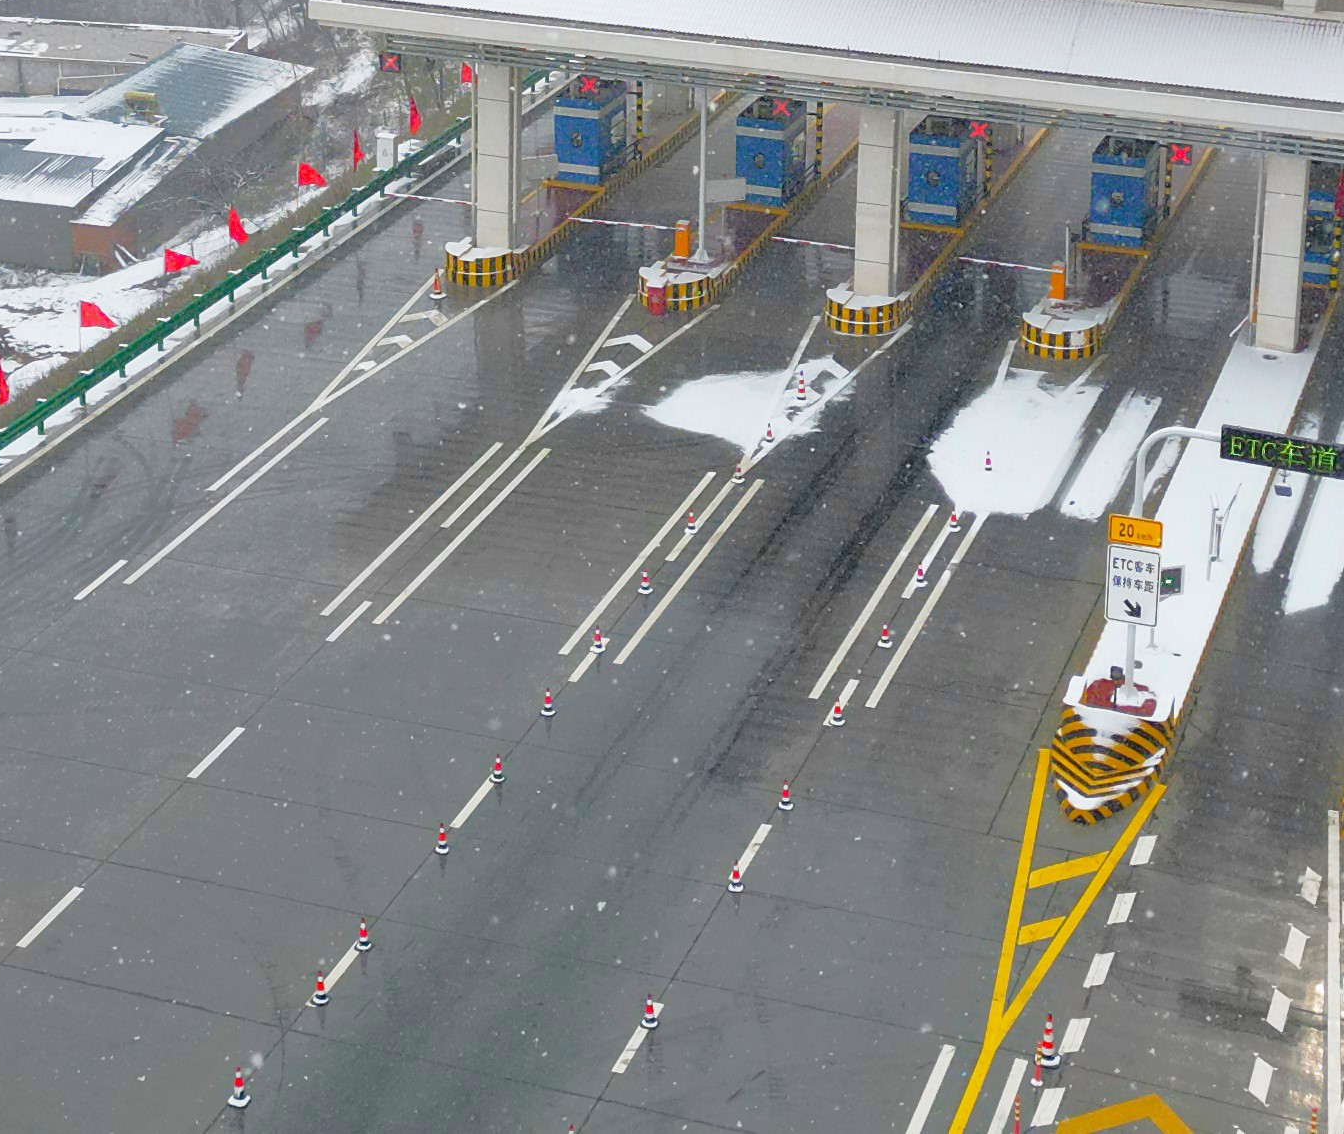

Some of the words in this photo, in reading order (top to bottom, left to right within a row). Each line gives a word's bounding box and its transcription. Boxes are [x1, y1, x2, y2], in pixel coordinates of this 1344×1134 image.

[1229, 436, 1338, 473] ETC车道
[1118, 522, 1134, 538] 20
[1112, 556, 1156, 575] ETC客车
